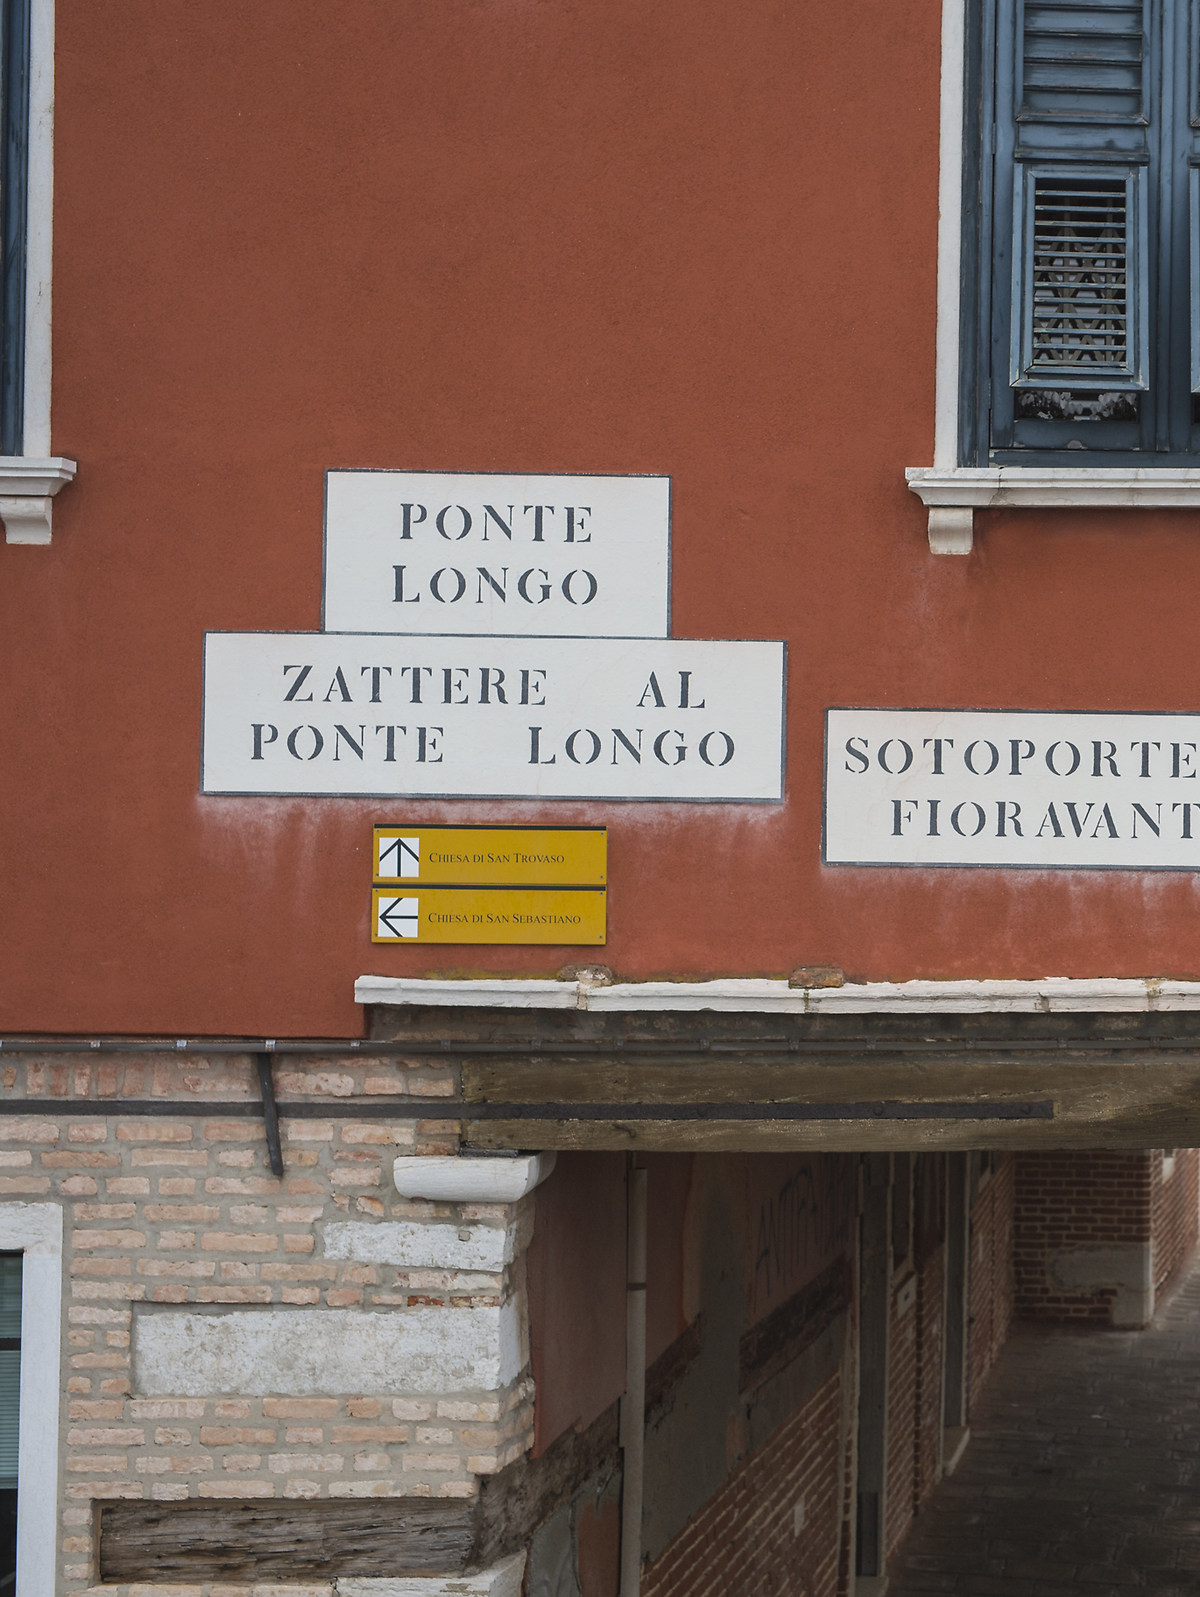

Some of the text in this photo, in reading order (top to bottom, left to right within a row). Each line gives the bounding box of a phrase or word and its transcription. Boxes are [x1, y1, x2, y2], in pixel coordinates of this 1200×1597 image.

[399, 503, 592, 543] PONTE
[392, 565, 598, 605] LONGO
[283, 665, 706, 709] ZATTERE AL
[250, 723, 735, 767] PONTE LONGO
[429, 852, 470, 863] CHIESA
[487, 852, 510, 863] SAN
[513, 853, 565, 864] TROVASO
[428, 912, 468, 923] CHIESA
[486, 913, 509, 923] SAN
[512, 913, 581, 924] SEBASTIANO
